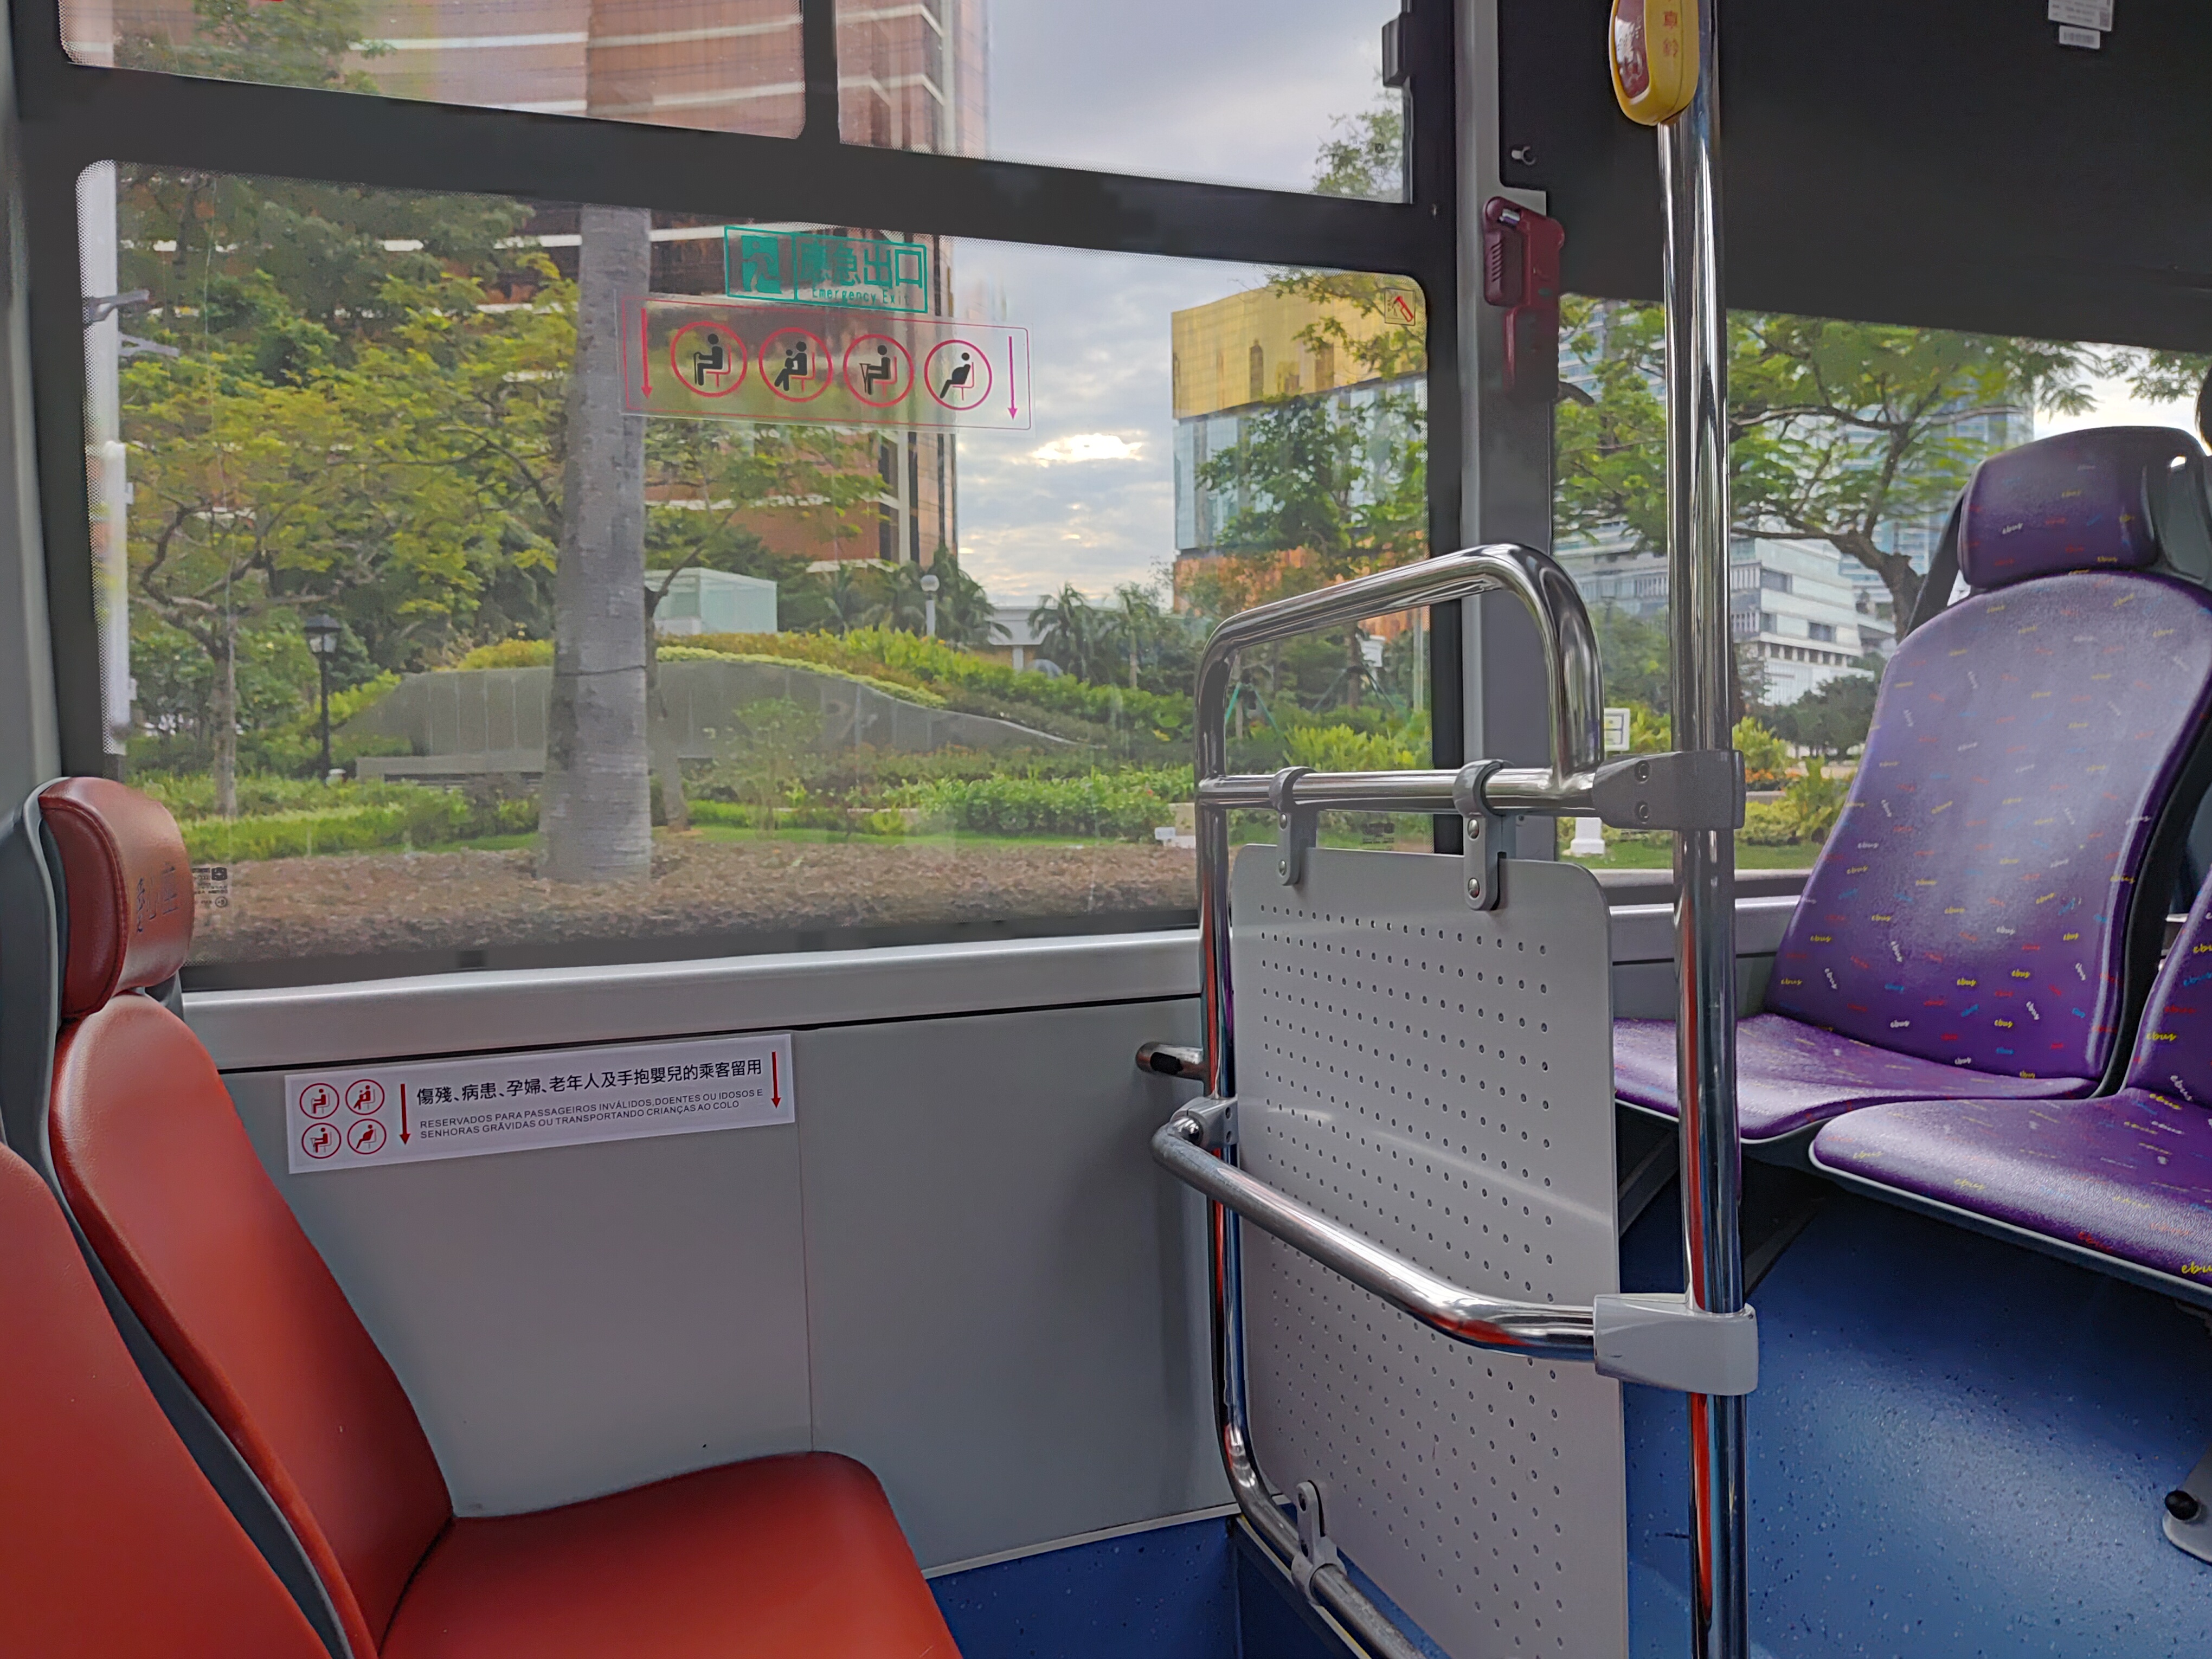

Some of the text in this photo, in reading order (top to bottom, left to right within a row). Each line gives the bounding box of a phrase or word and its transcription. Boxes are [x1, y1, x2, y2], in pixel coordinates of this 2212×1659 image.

[812, 288, 910, 306] Emergency Exit
[420, 1114, 492, 1129] RESERVADOS
[496, 1112, 523, 1122] PARA
[525, 1104, 597, 1118] PASSAGEIROS
[703, 1092, 717, 1101] OU
[719, 1089, 755, 1099] IDOSOS
[757, 1089, 763, 1097] E
[421, 1126, 480, 1139] SENHORAS
[538, 1119, 554, 1127] OU
[556, 1108, 644, 1126] TRANSPORTANDO
[647, 1104, 696, 1115] CRIANÇAS
[697, 1102, 711, 1111] AO
[713, 1100, 740, 1110] COLO
